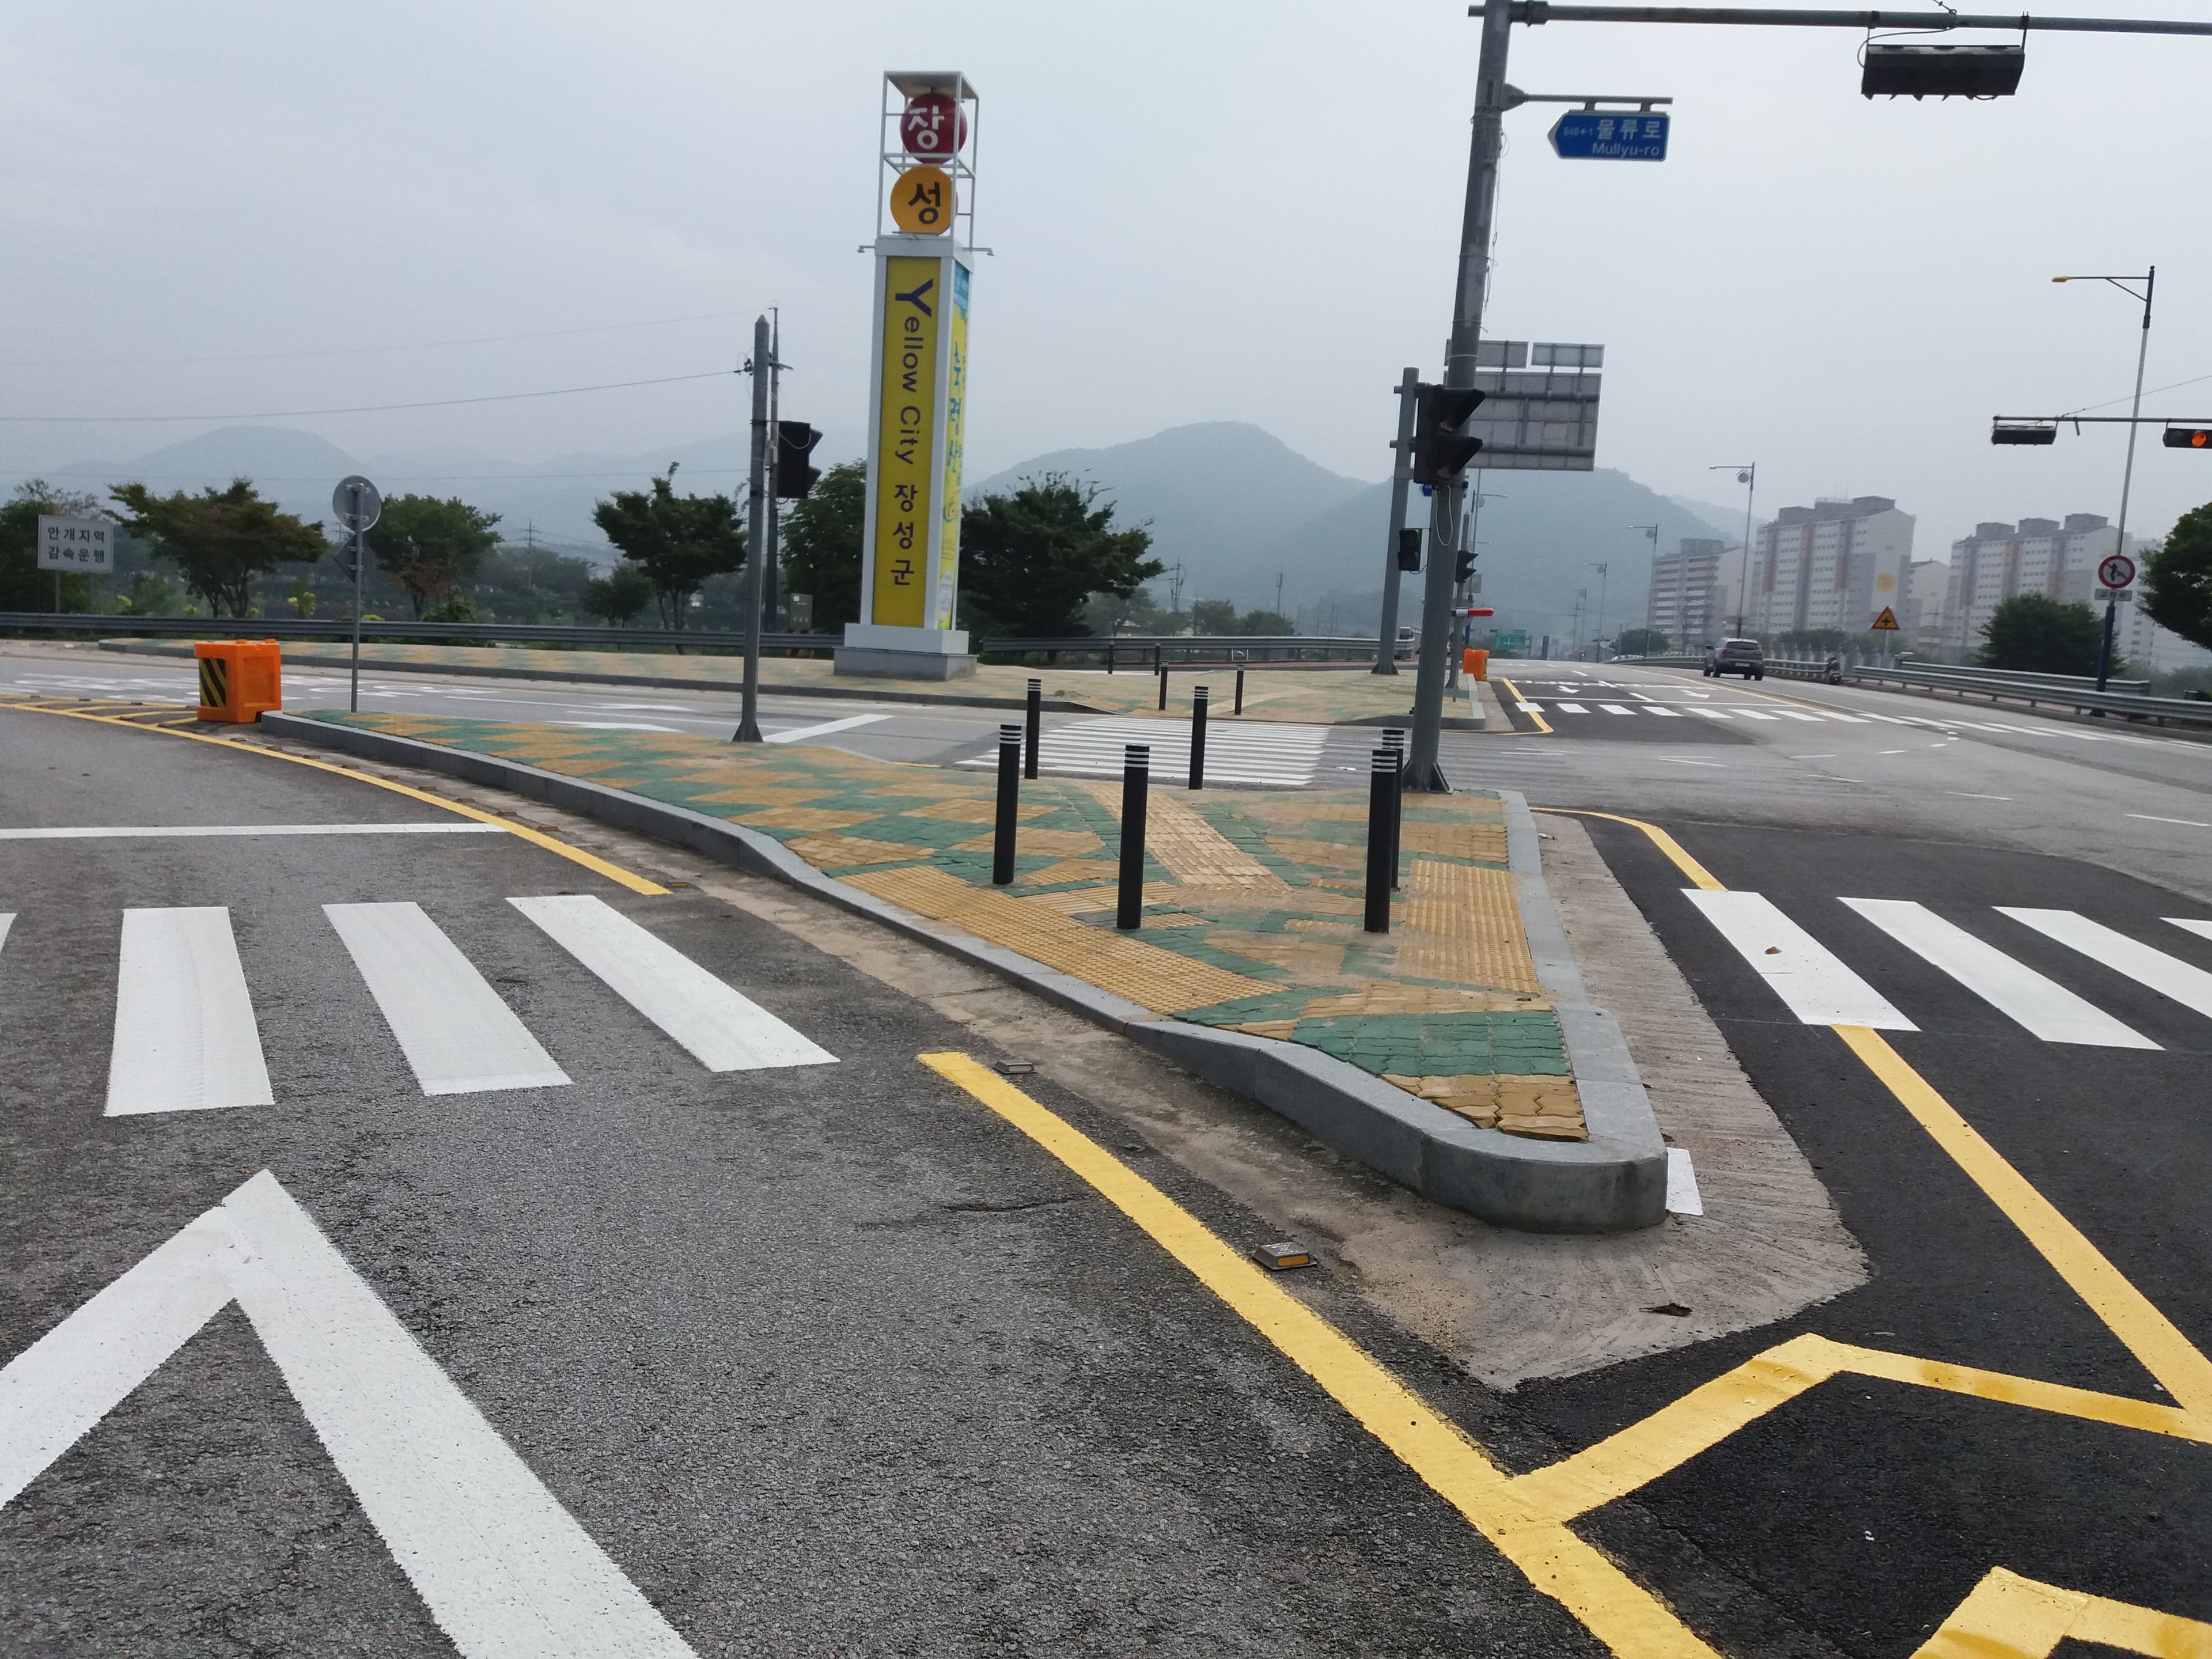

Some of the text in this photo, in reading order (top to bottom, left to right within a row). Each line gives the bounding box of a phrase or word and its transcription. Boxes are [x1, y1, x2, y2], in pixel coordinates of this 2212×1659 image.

[1597, 119, 1662, 141] 물류로
[1592, 142, 1660, 157] Mullyu-ro
[895, 278, 934, 465] Yellow City
[47, 527, 104, 543] 안개지역
[891, 484, 918, 586] 장성군
[48, 547, 104, 563] 감속운행
